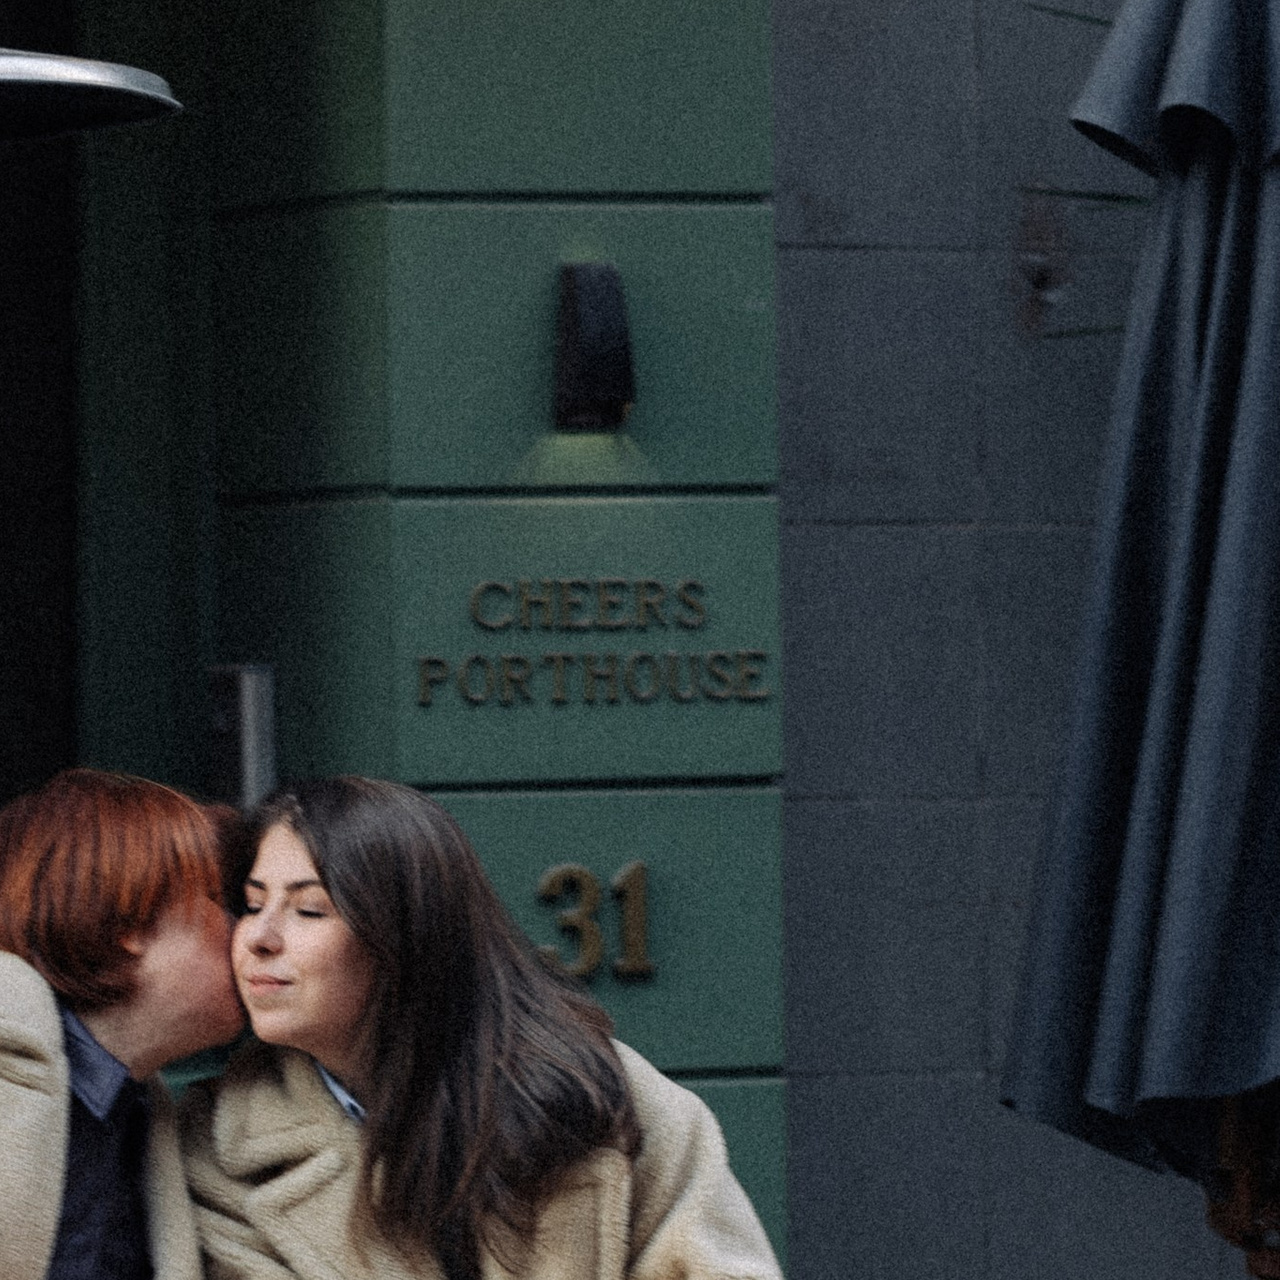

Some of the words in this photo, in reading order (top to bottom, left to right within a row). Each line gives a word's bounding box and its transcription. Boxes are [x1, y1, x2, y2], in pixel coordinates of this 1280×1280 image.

[470, 577, 707, 632] CHEERS
[416, 651, 772, 708] PORTHOUSE
[536, 861, 654, 983] 31
